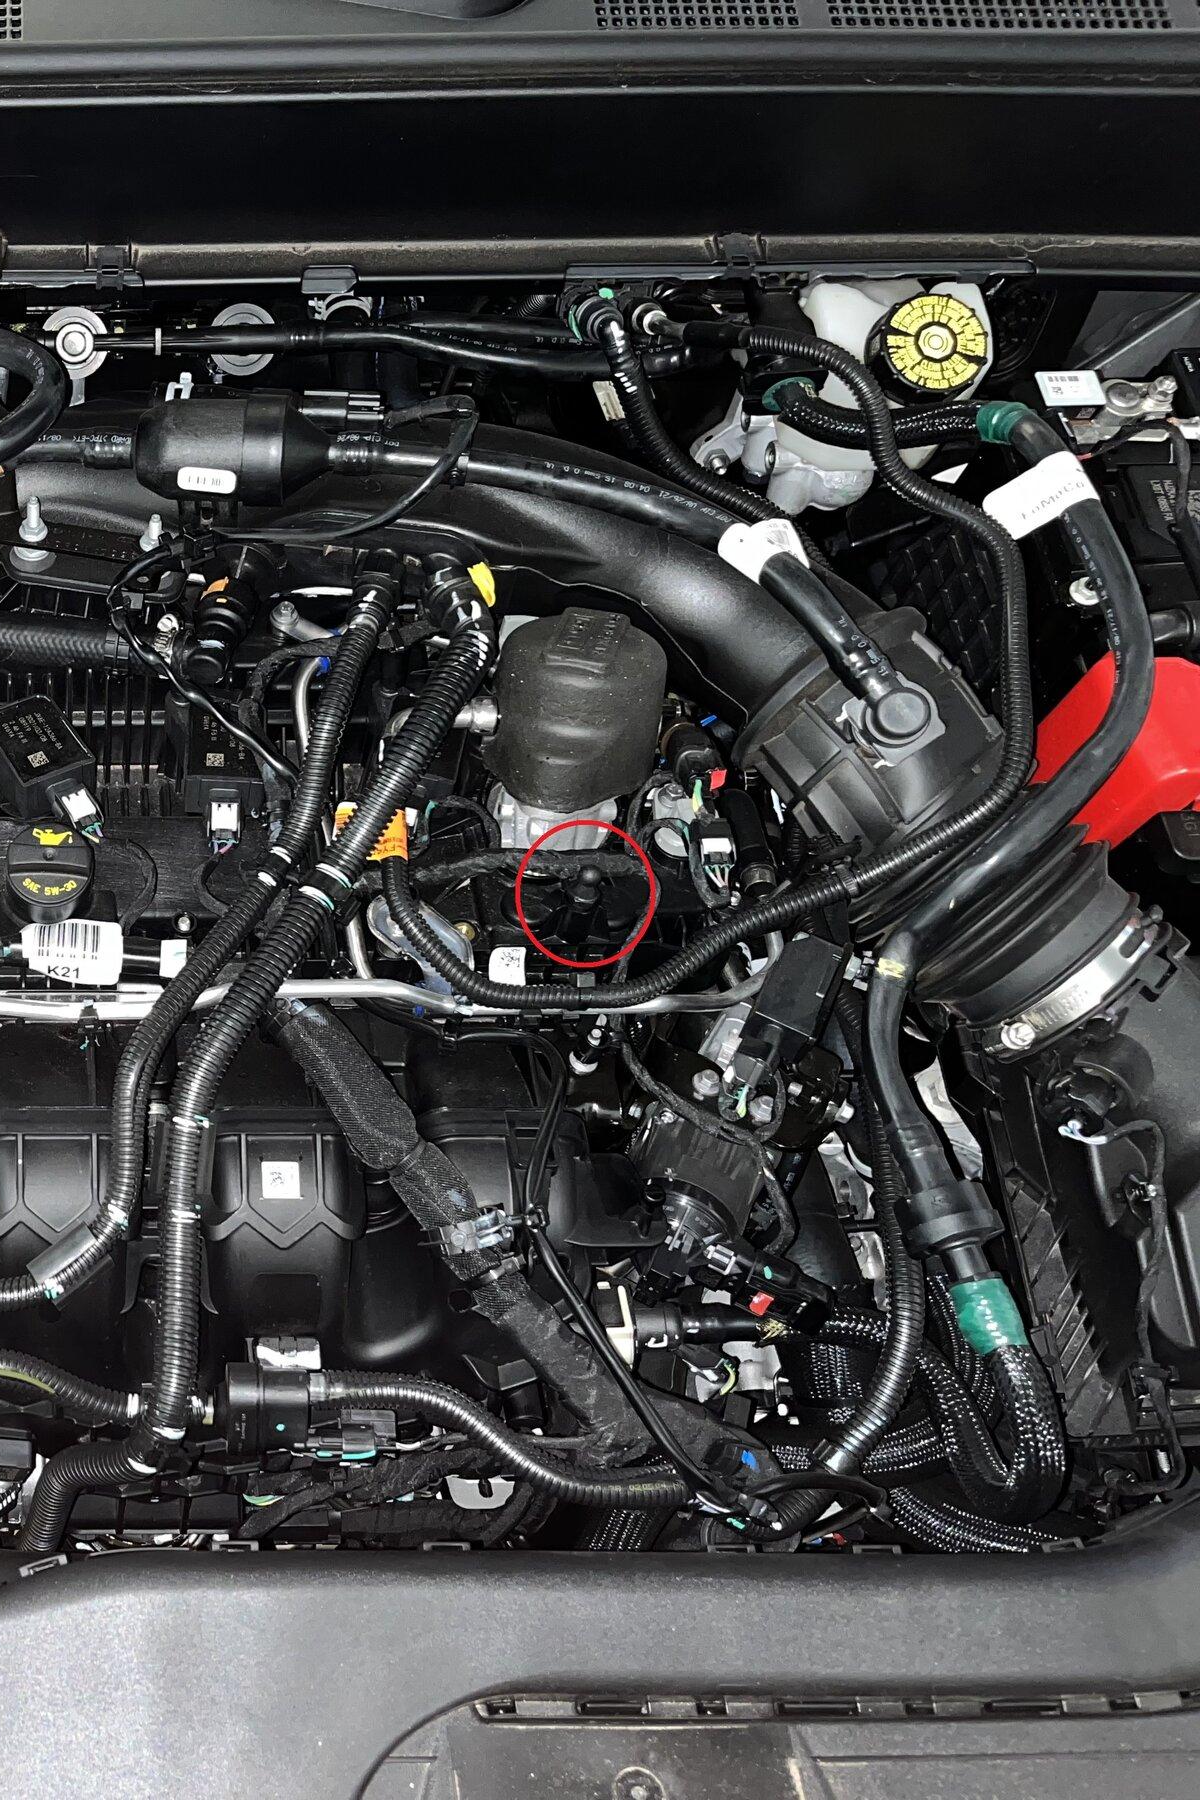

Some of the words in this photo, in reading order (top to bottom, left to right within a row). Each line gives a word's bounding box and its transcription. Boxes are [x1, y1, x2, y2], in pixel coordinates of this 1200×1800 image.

[22, 877, 41, 894] SAE
[44, 879, 77, 896] 5W-30
[47, 965, 80, 979] K21
